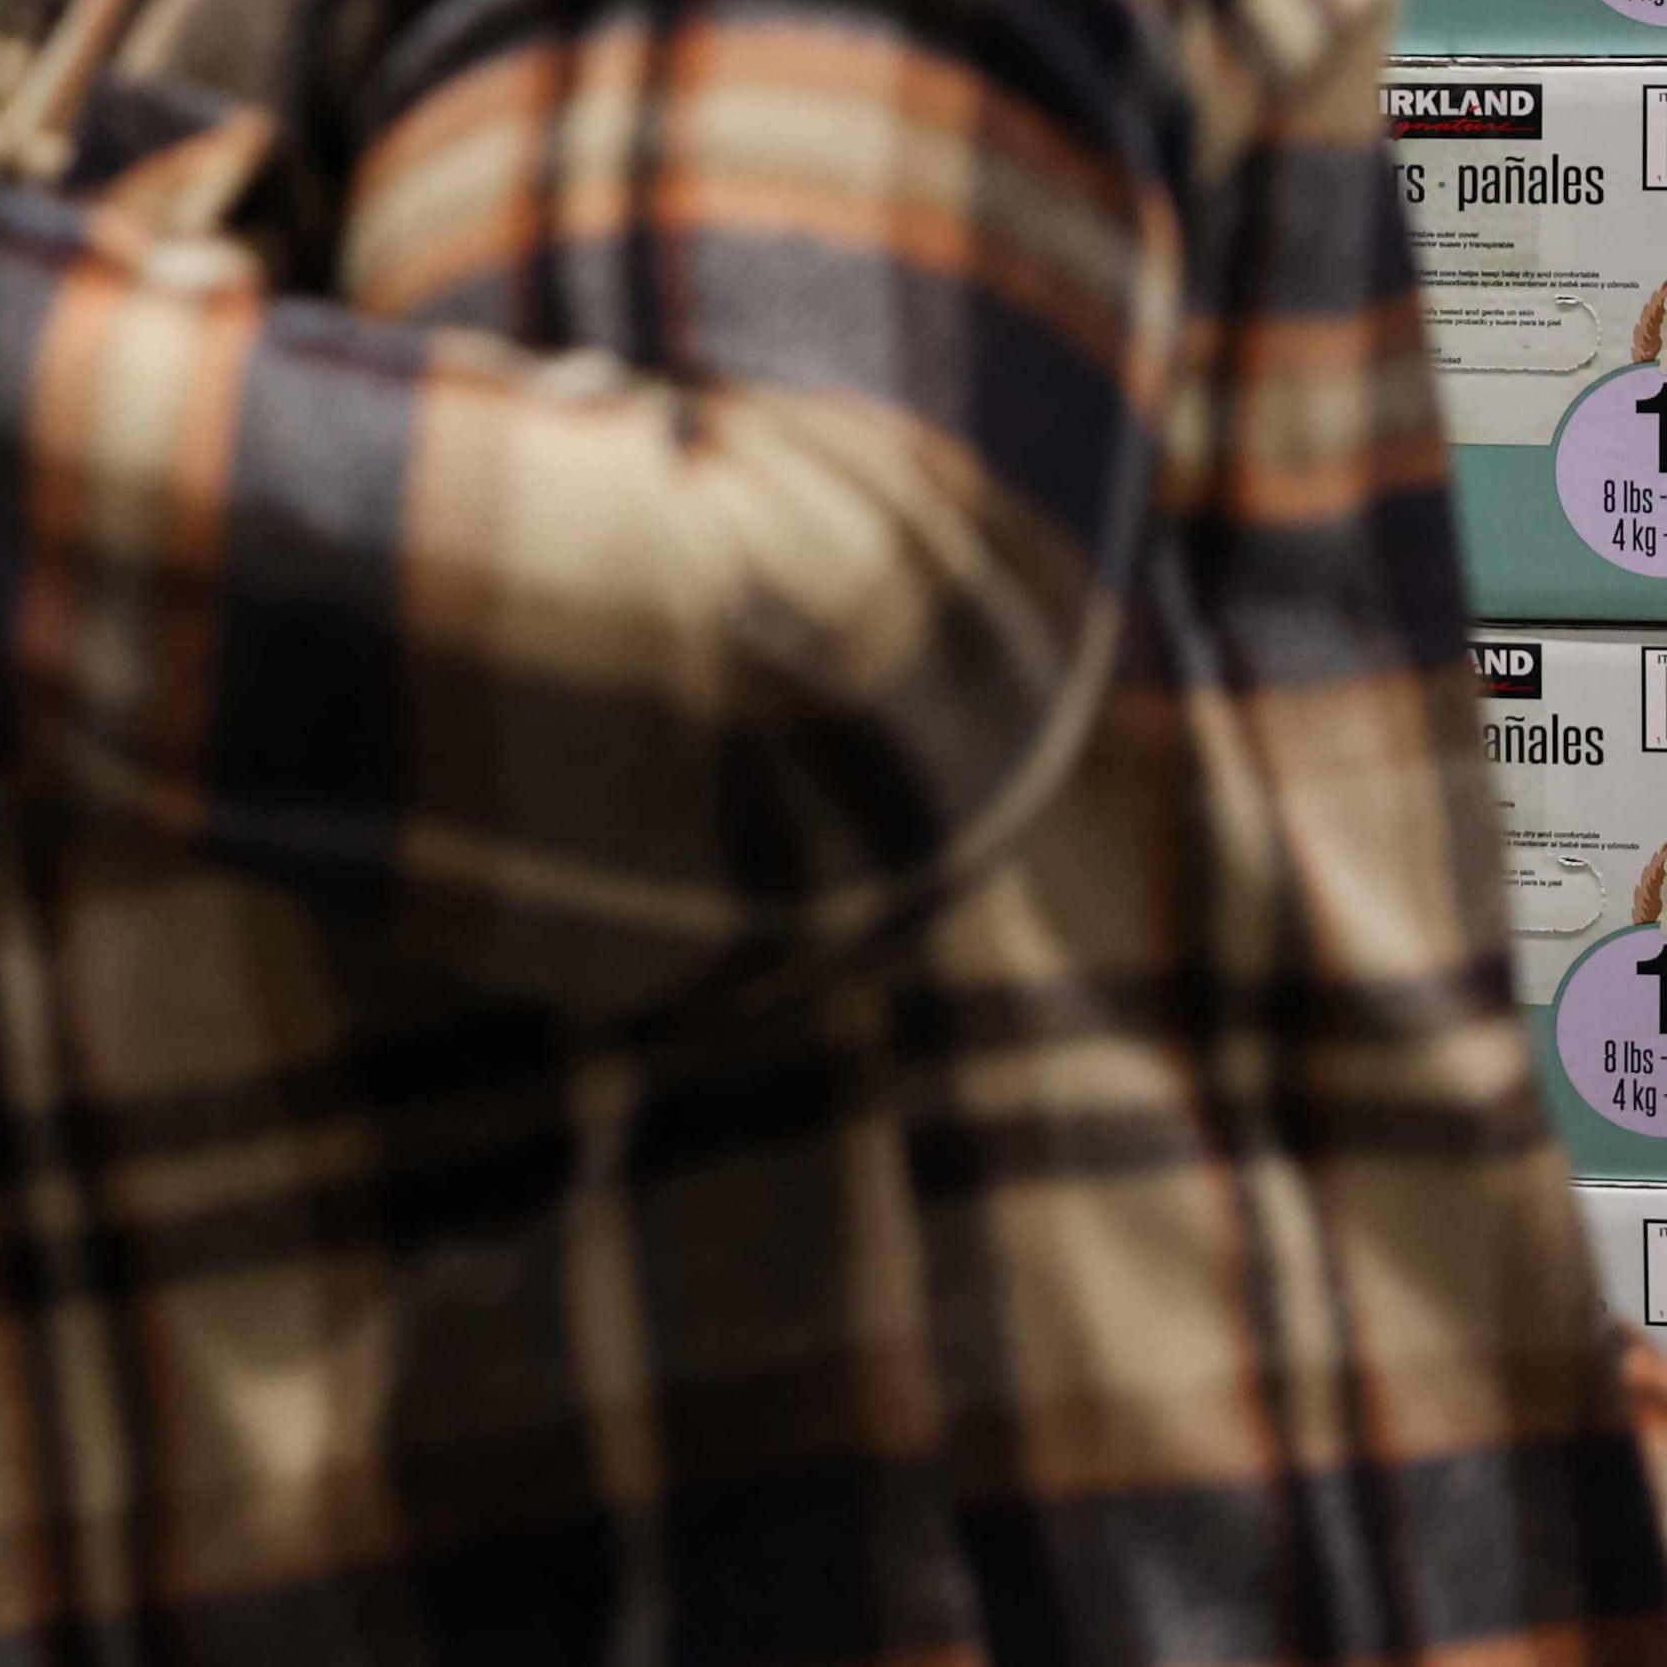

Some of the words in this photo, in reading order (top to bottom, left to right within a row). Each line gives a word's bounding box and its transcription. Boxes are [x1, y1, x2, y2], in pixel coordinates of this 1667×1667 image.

[1457, 154, 1605, 212] pañales
[1603, 480, 1617, 514] 8
[1623, 479, 1654, 514] lbs
[1612, 519, 1625, 551] 4
[1631, 519, 1657, 558] kg
[1603, 1039, 1617, 1074] 8
[1623, 1039, 1654, 1074] lbs
[1612, 1078, 1626, 1111] 4
[1631, 1078, 1657, 1118] kg
